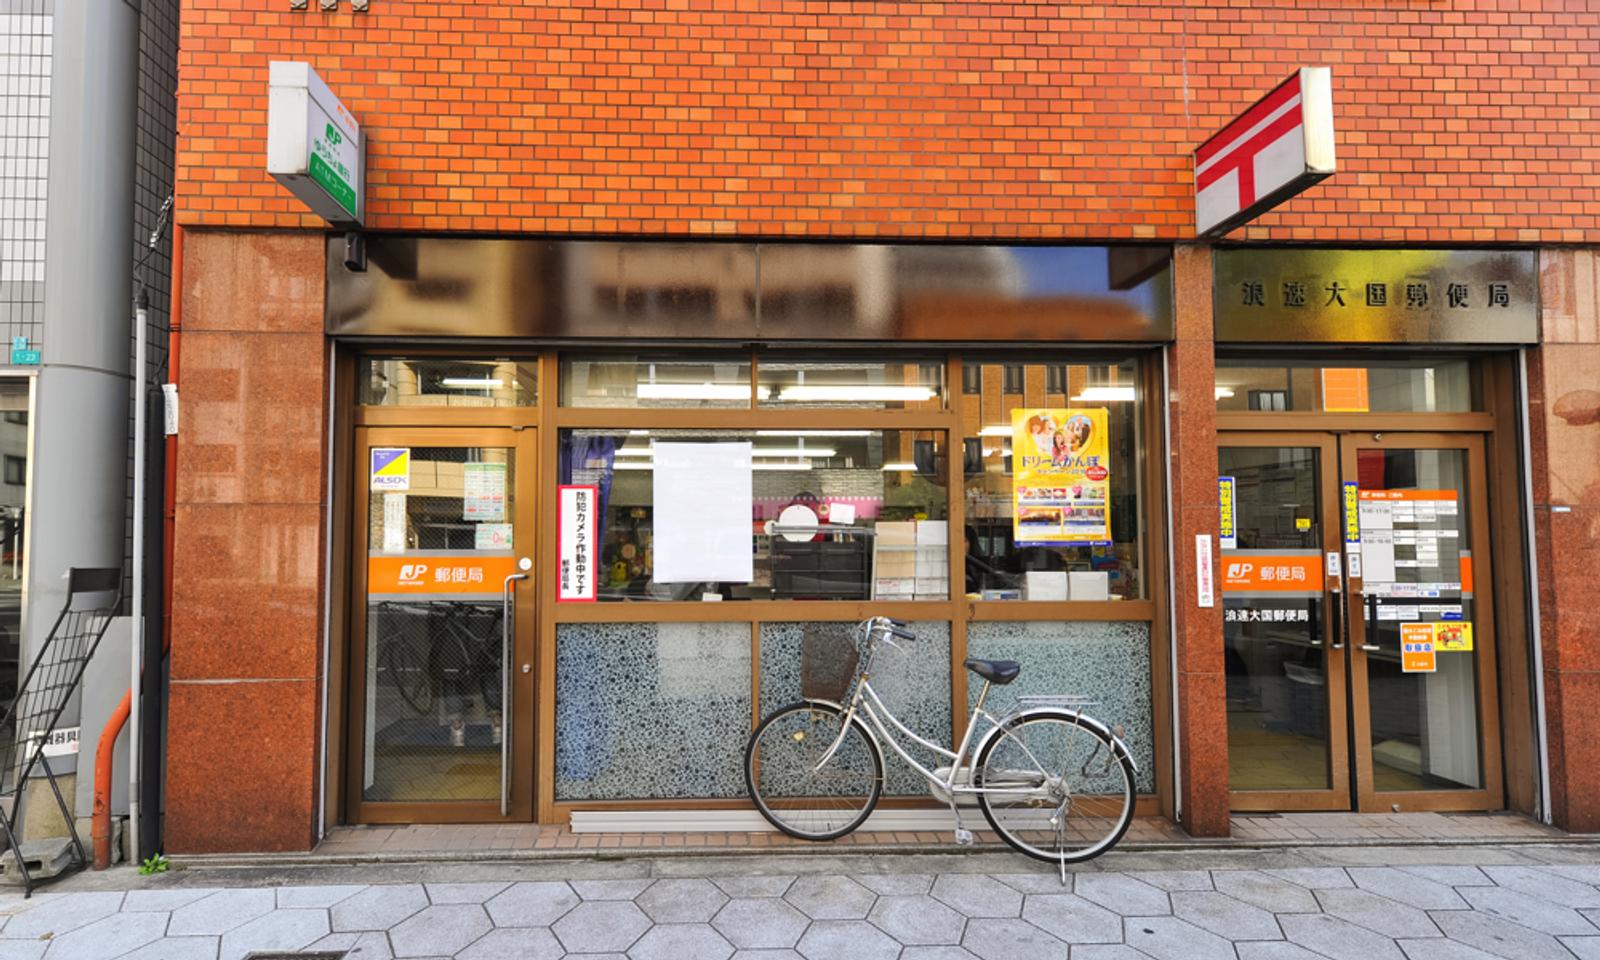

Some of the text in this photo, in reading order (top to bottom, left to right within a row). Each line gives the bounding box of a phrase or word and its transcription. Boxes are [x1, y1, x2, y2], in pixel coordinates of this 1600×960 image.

[1242, 281, 1510, 308] 浪速大国郵便局
[373, 477, 407, 485] ALSOK
[575, 491, 587, 595] 防犯カメラ作動中です
[434, 567, 484, 583] 郵便局
[1260, 566, 1306, 581] 郵便局
[1225, 609, 1309, 622] 浪速大国郵便局
